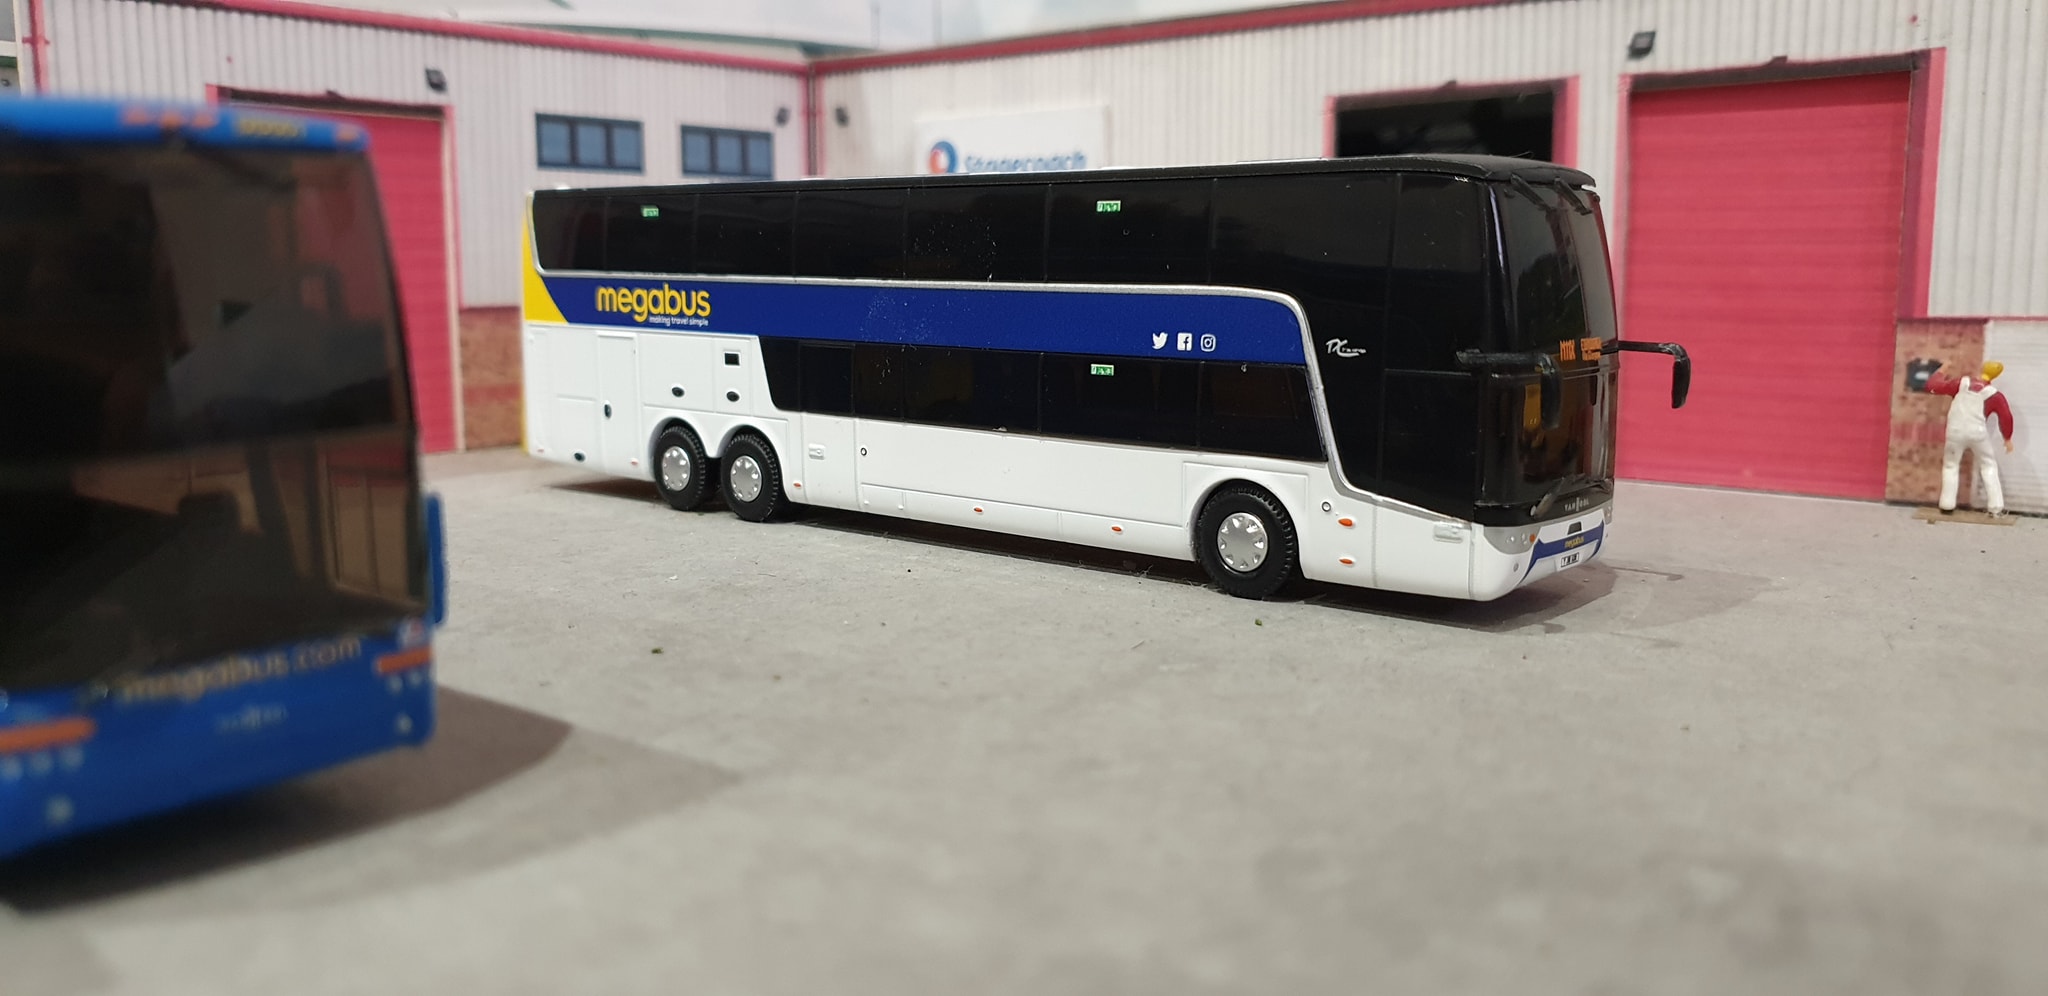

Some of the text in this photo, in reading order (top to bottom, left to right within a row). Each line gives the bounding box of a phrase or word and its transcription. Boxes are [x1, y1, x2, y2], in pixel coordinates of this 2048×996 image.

[596, 283, 711, 323] megabus
[649, 315, 709, 327] making travel simple
